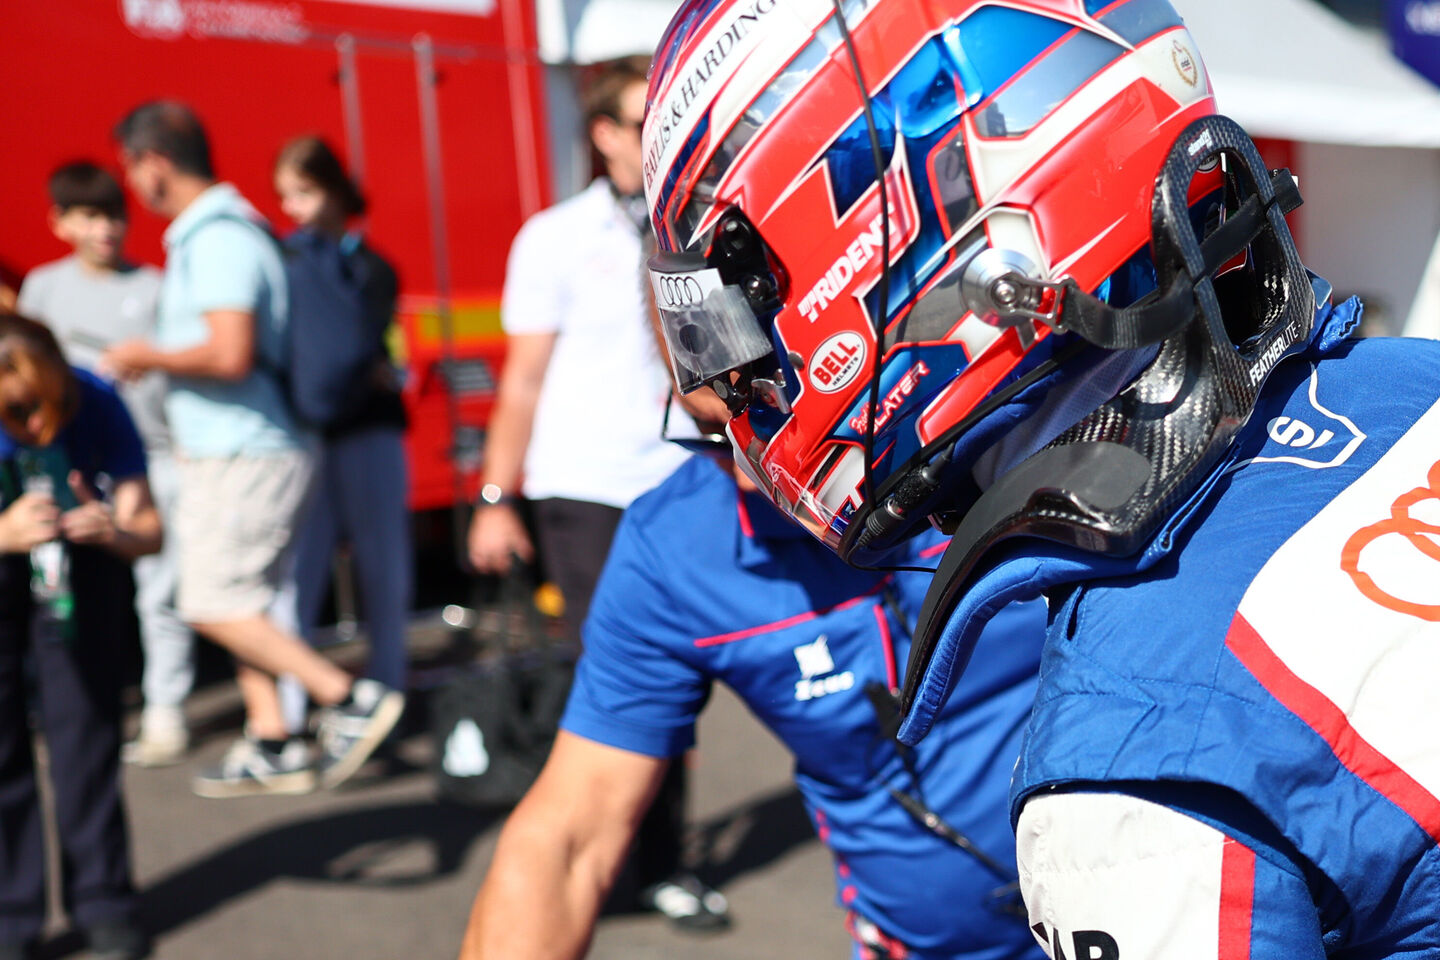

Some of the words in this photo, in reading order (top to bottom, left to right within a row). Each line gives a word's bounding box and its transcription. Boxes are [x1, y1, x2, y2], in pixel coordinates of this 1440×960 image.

[644, 115, 672, 190] BAYLIS
[671, 101, 684, 127] &
[812, 341, 858, 386] BELL
[832, 356, 859, 387] HELMETS
